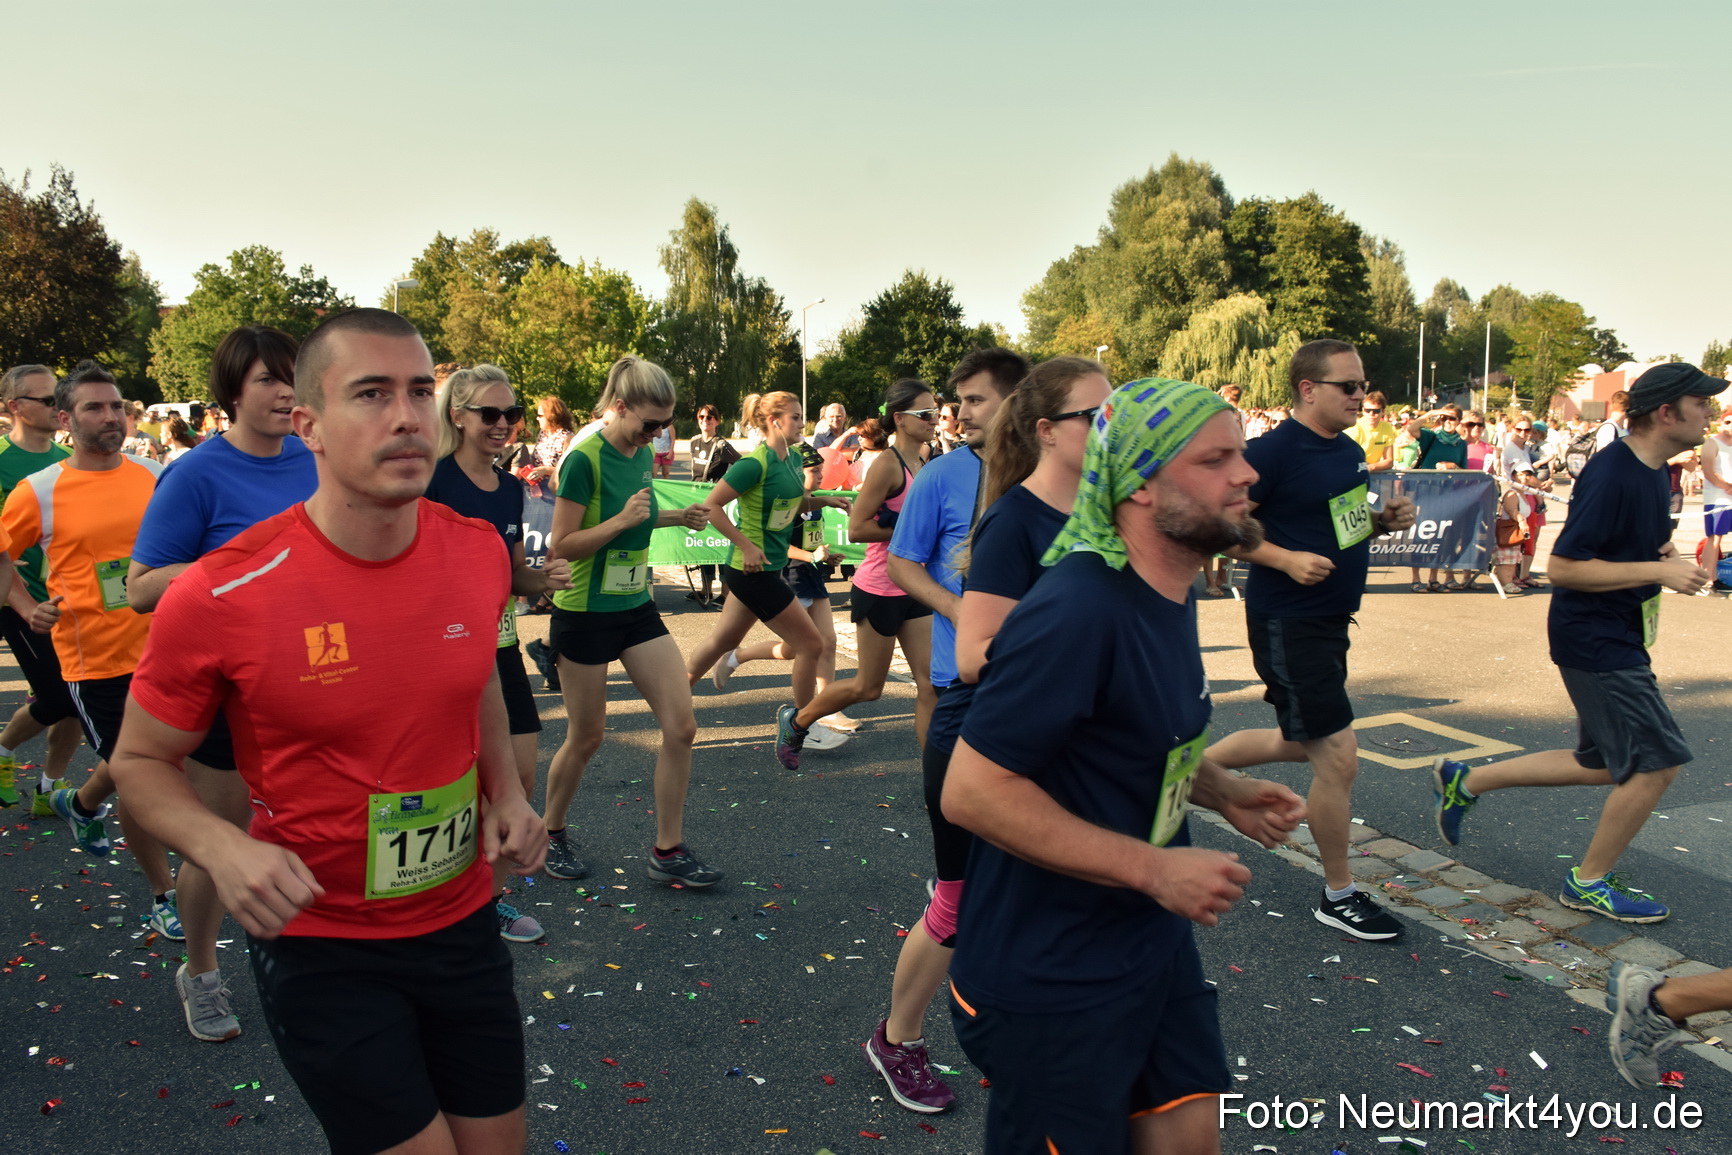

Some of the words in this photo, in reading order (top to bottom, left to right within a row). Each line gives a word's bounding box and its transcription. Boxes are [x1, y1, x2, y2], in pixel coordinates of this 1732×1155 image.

[1340, 504, 1367, 531] 1045
[685, 536, 704, 547] Die
[1369, 543, 1440, 554] OMOBILE
[629, 566, 636, 582] 1
[389, 807, 472, 868] 1712
[397, 866, 429, 879] Weiss
[431, 847, 468, 871] Sebastian
